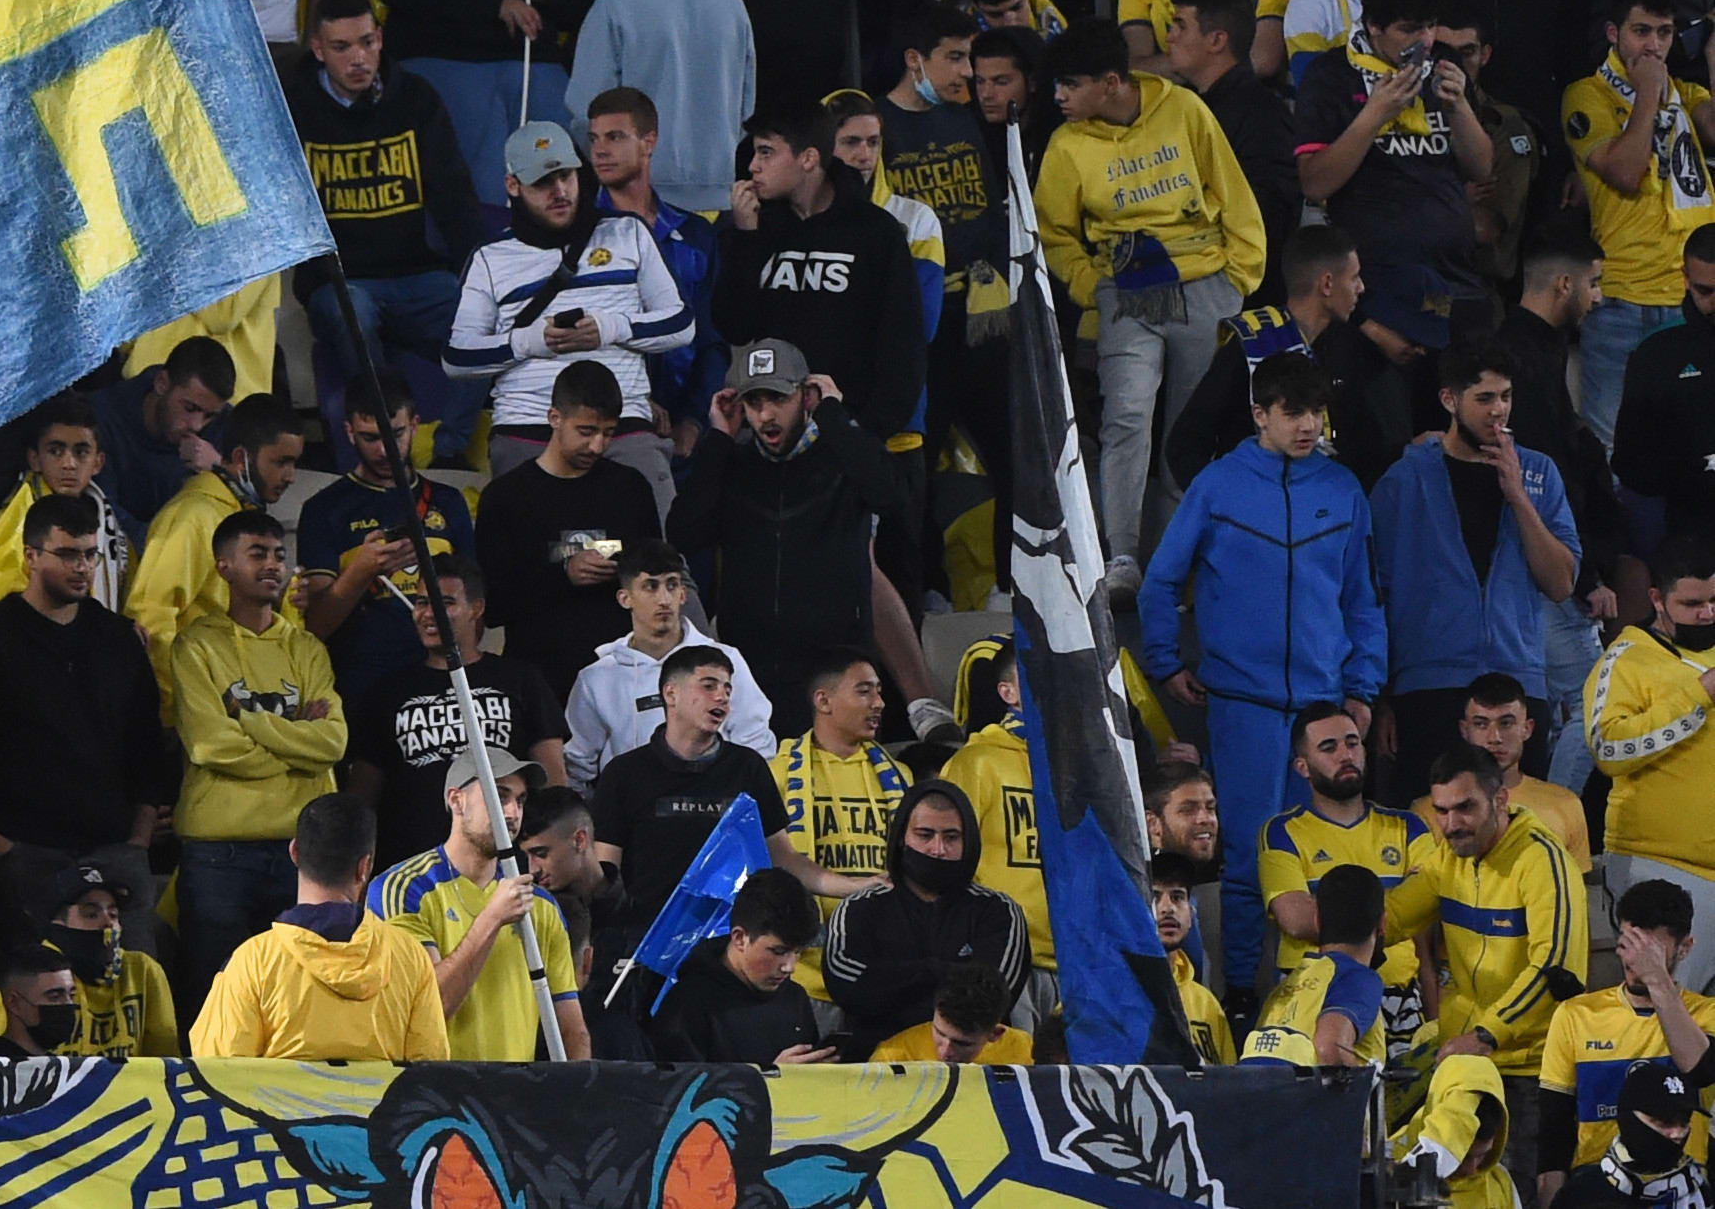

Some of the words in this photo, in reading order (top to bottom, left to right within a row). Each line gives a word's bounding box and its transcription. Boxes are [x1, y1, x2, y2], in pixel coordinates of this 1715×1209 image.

[315, 146, 412, 187] MACCABI
[327, 180, 406, 211] FANATICS
[913, 181, 988, 208] NATICS
[350, 518, 380, 533] FILA
[396, 720, 512, 758] FANATCS
[672, 801, 723, 812] REPLAY
[815, 844, 887, 871] FANATICS
[1586, 1039, 1614, 1051] FILA
